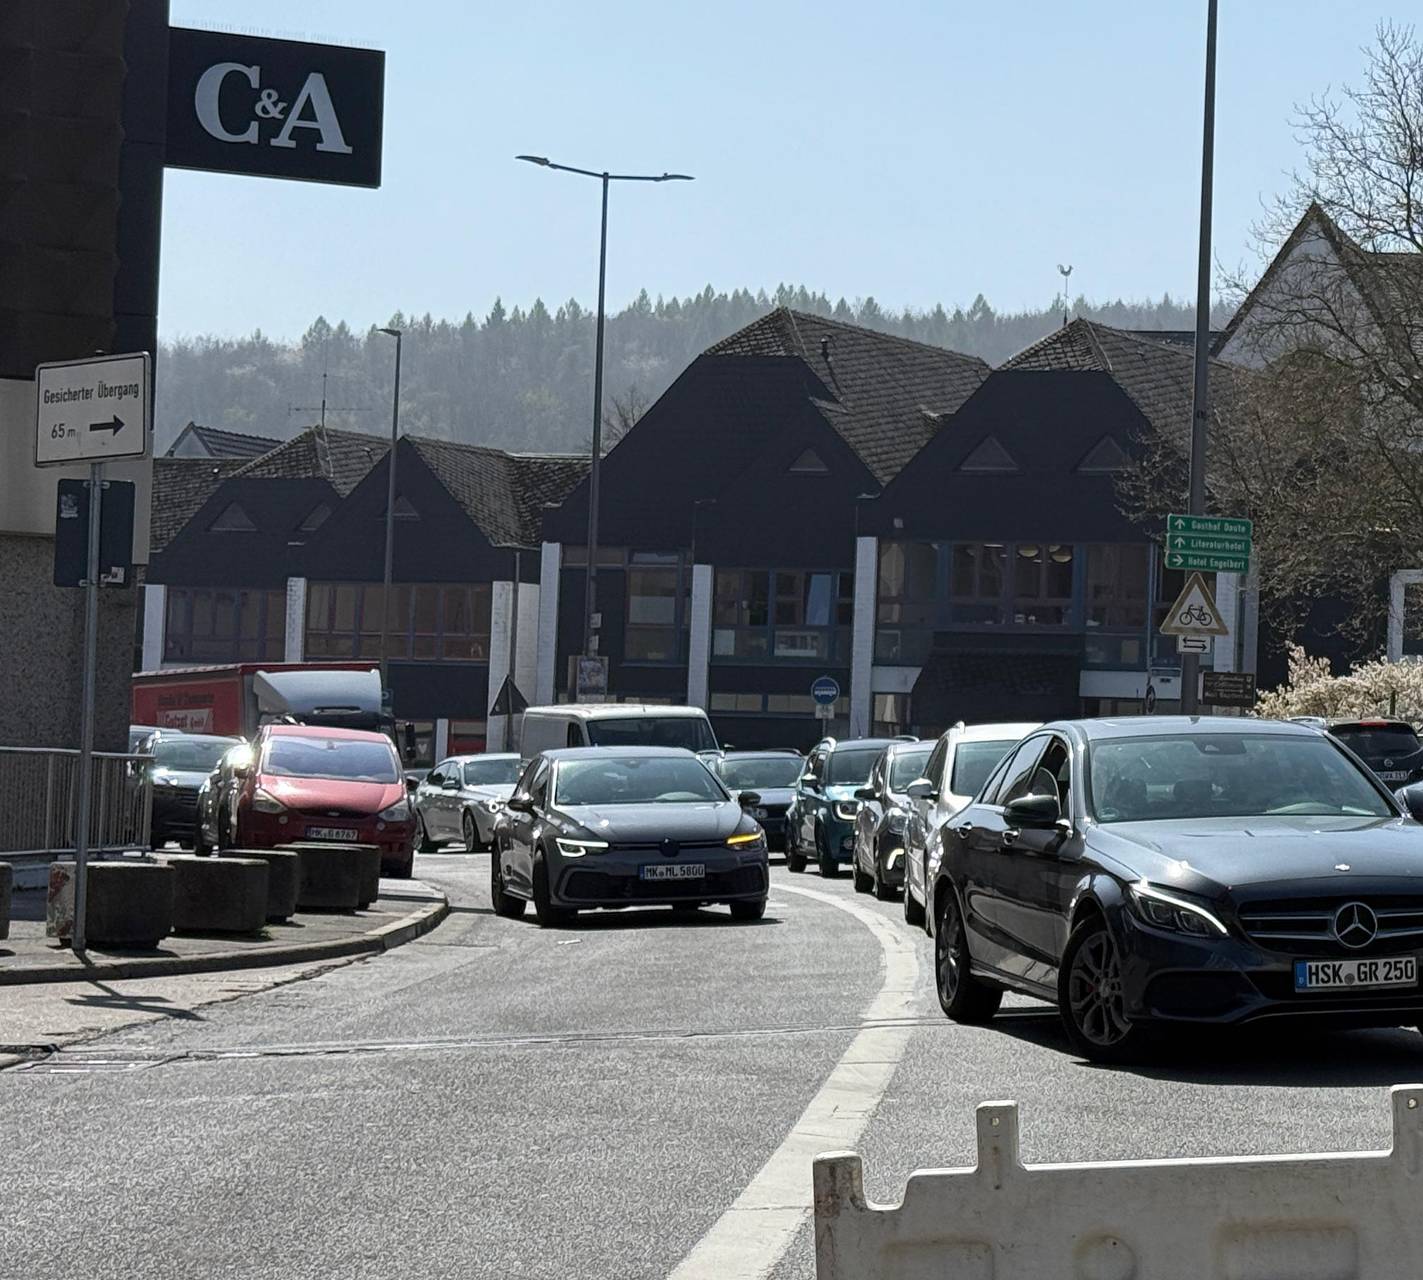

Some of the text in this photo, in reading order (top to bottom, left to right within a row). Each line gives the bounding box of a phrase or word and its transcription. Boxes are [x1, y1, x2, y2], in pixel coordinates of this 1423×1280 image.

[195, 62, 353, 154] C&A
[43, 381, 139, 404] Gesicherter Übergang
[51, 423, 76, 439] 65 m
[1191, 520, 1221, 531] Gasthof
[1191, 539, 1245, 551] Literaturhotel
[1188, 556, 1245, 569] Hotel Engelbert
[645, 866, 658, 878] MK
[665, 866, 678, 877] ML
[1308, 963, 1343, 985] HSK
[1357, 961, 1379, 983] GR
[1383, 959, 1415, 982] 250
